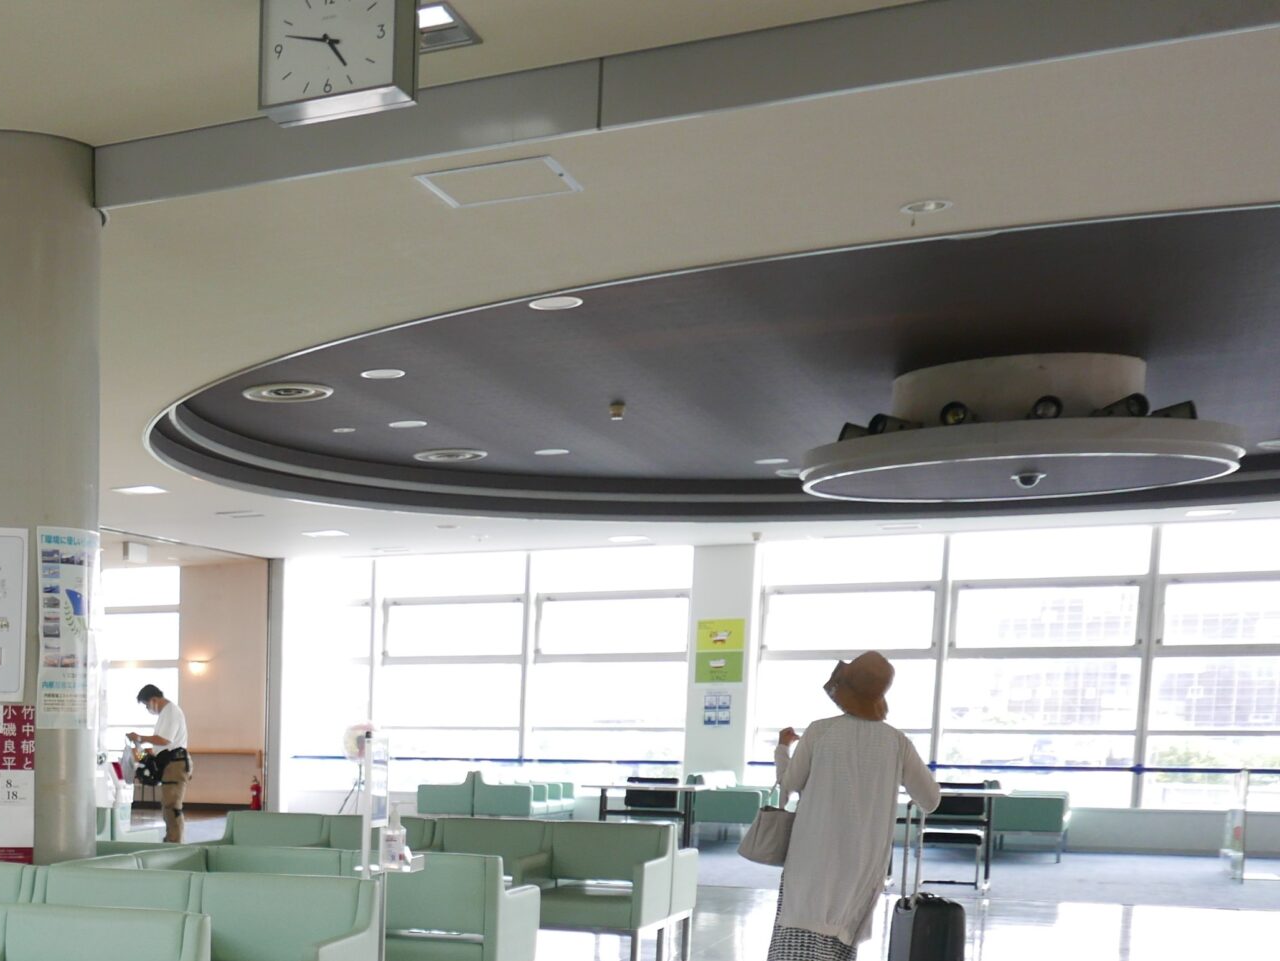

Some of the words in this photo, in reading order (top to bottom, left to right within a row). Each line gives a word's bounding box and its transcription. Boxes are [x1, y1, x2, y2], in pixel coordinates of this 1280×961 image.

[376, 24, 386, 39] 3
[274, 44, 283, 59] 9
[323, 78, 332, 93] 6
[3, 705, 17, 771] 小磯良平
[21, 705, 36, 770] 竹中郁と
[6, 779, 13, 788] 8
[7, 791, 18, 800] 18
